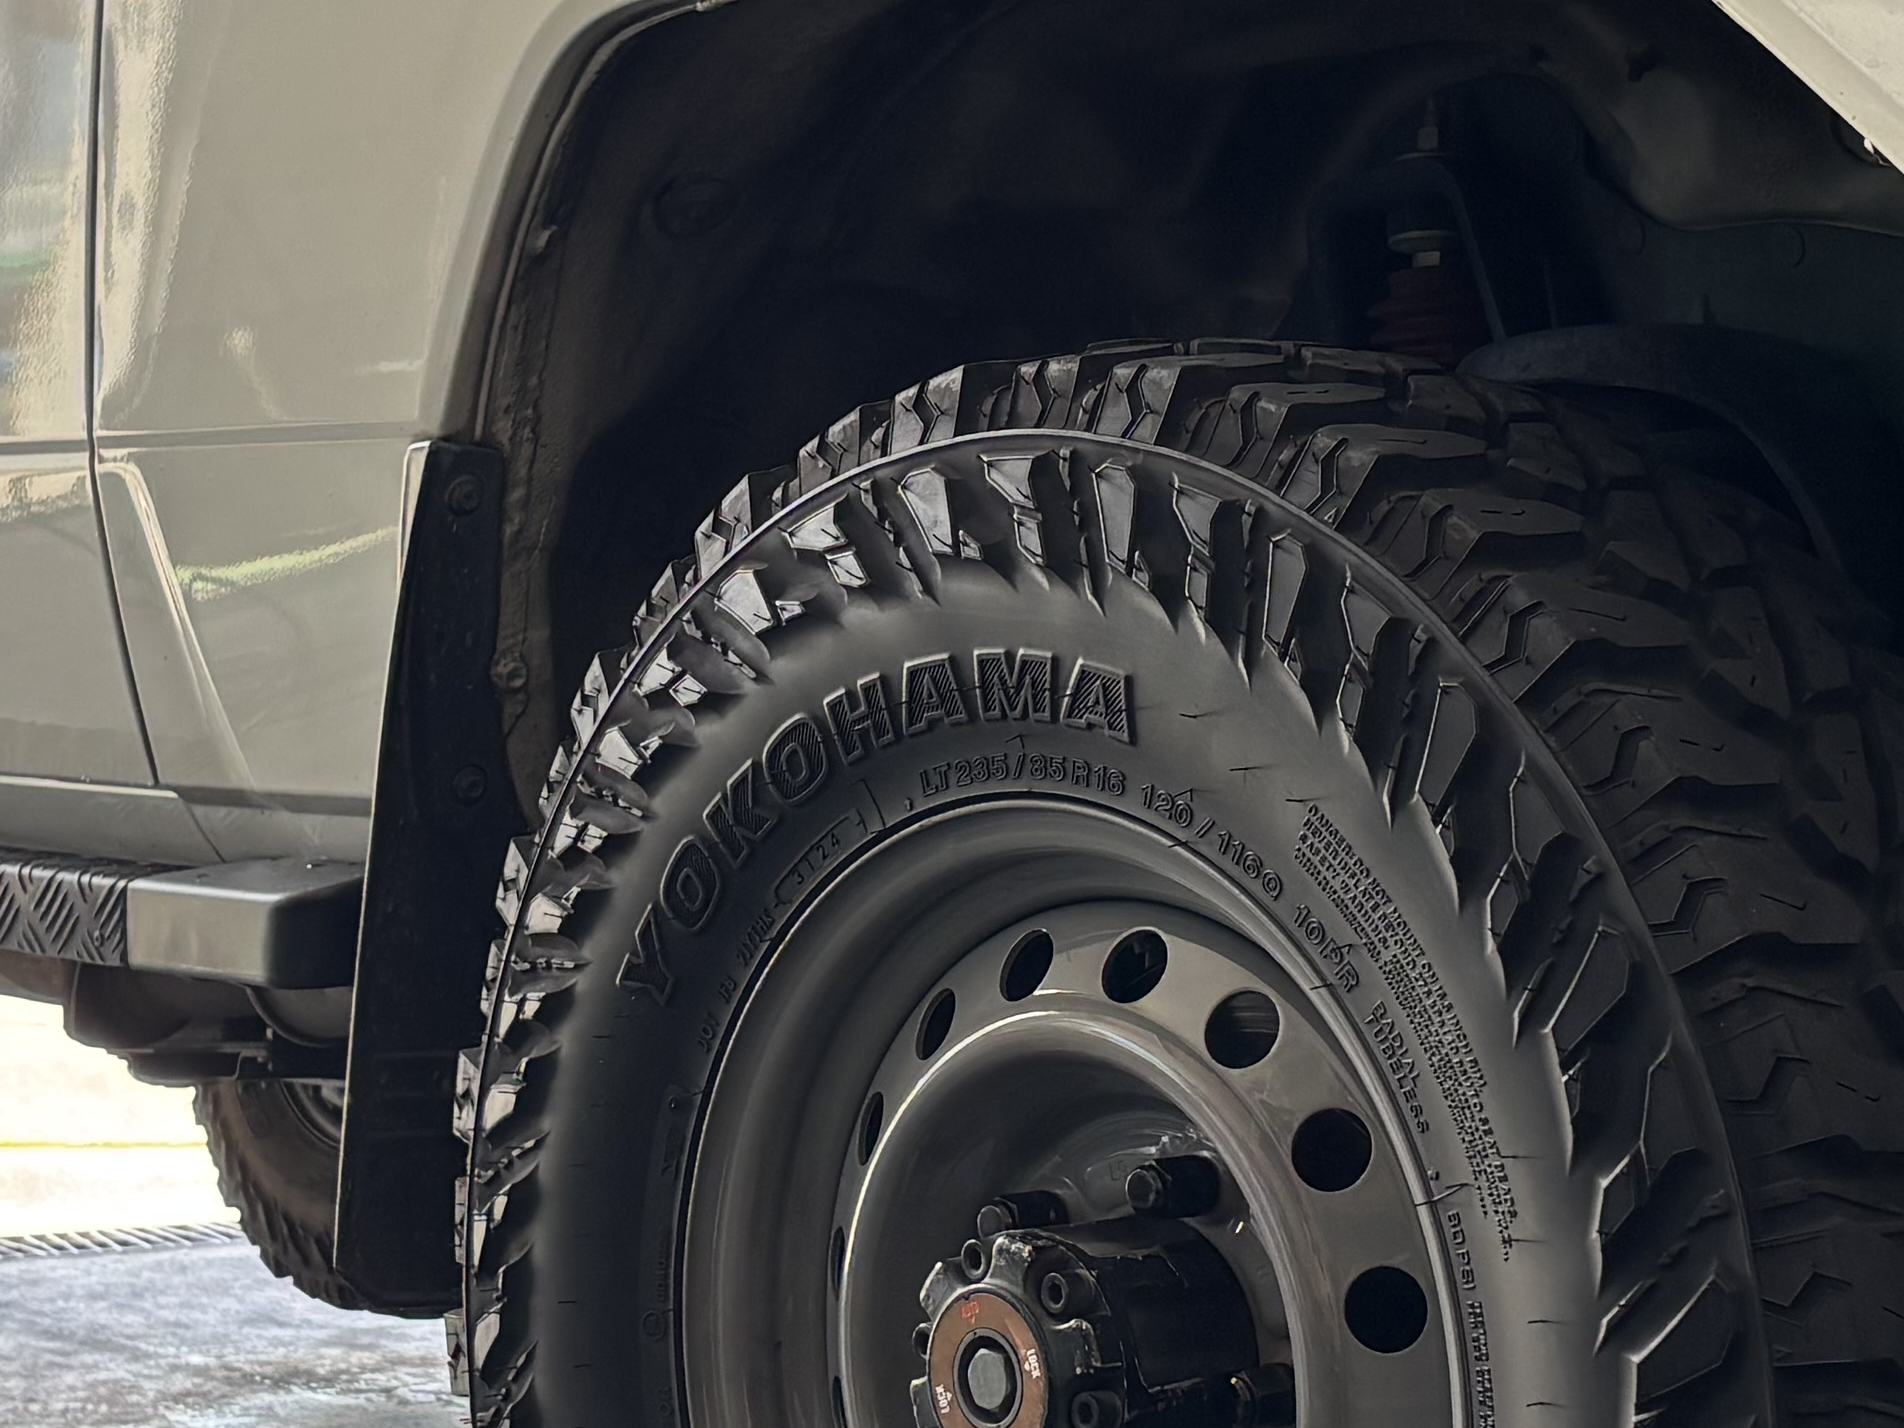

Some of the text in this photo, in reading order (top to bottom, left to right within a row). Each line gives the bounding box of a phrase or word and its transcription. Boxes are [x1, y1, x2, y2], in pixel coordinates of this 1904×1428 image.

[619, 648, 1137, 1003] YOKOHAMA
[1294, 903, 1360, 993] 10PR
[1364, 1014, 1430, 1135] TUBELESS
[1373, 1000, 1421, 1089] RADIAL
